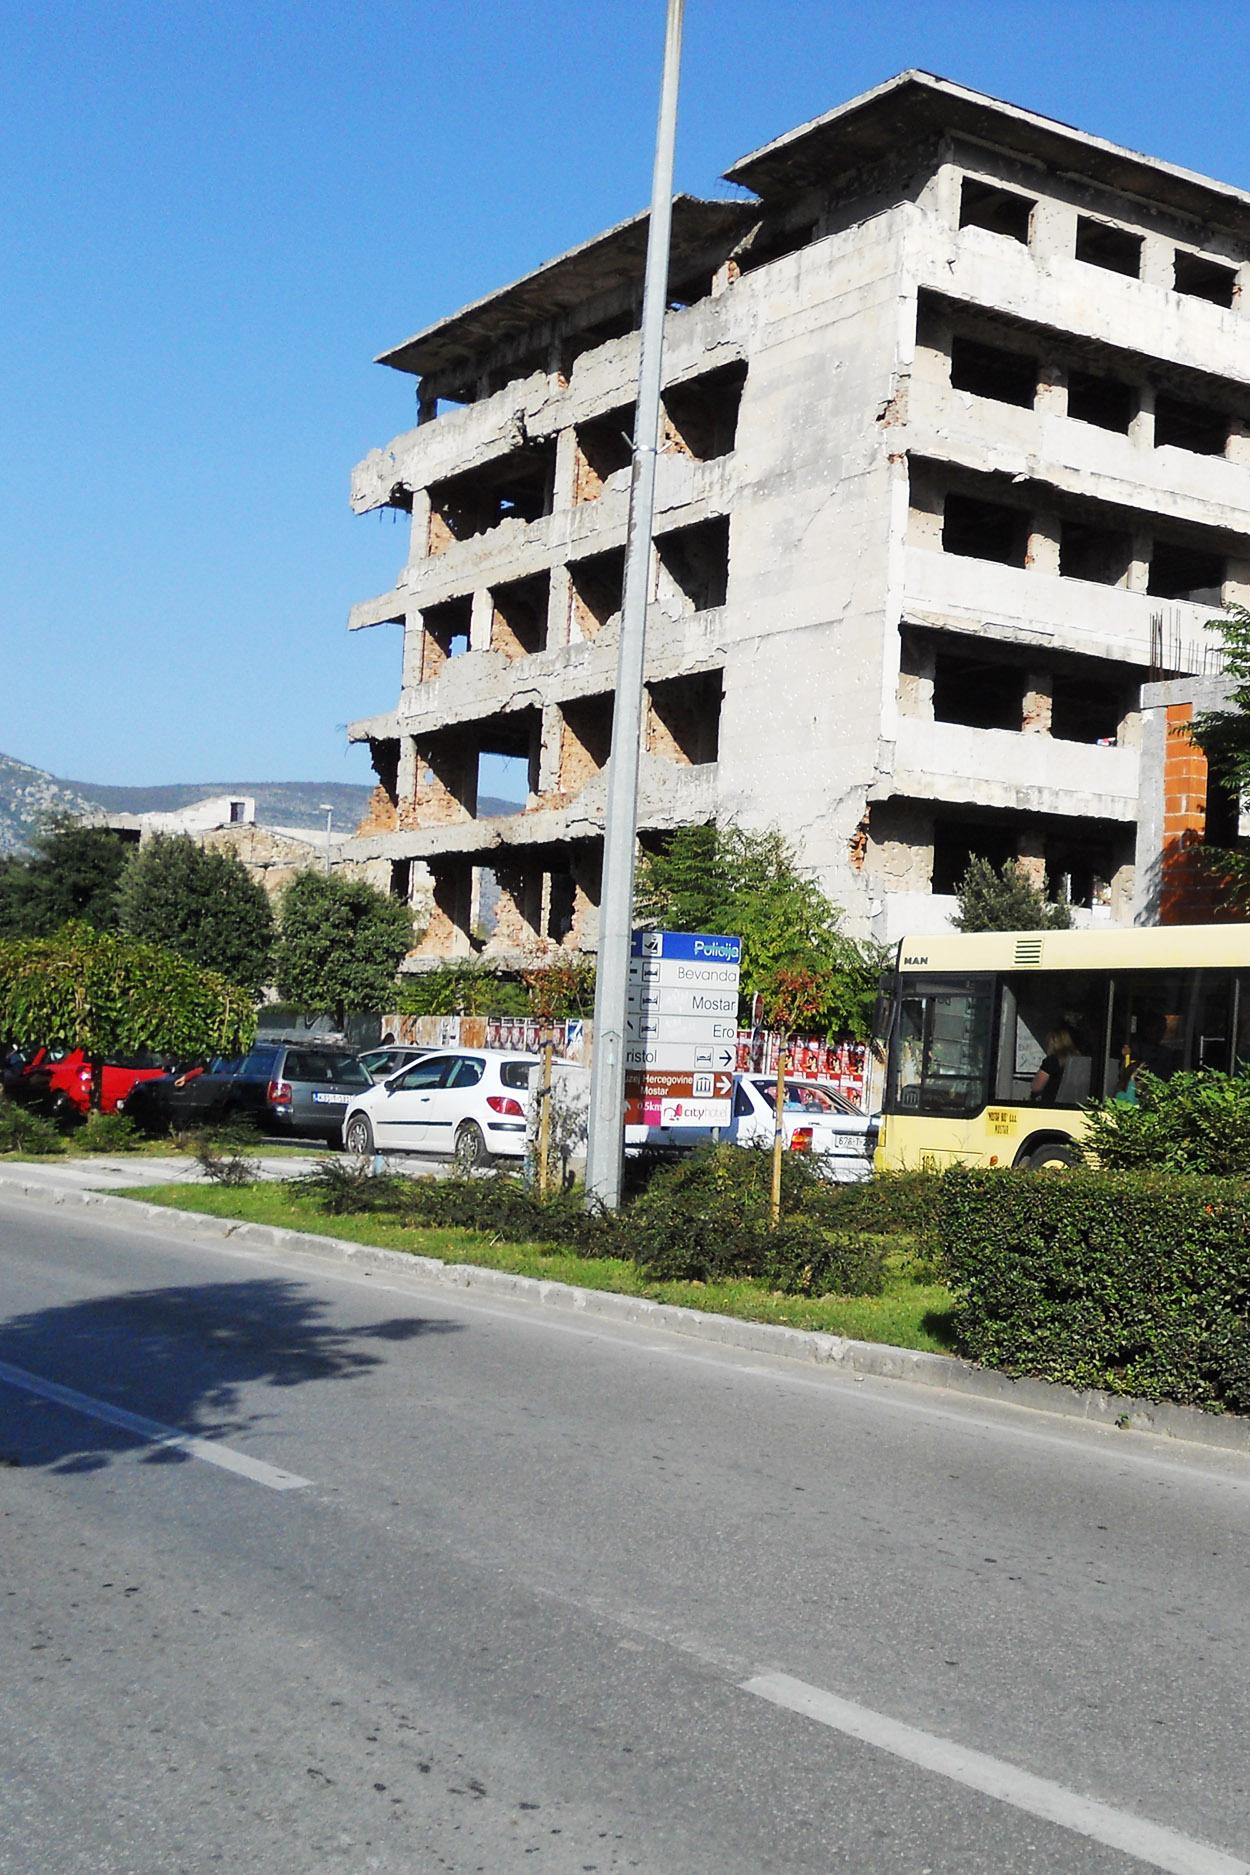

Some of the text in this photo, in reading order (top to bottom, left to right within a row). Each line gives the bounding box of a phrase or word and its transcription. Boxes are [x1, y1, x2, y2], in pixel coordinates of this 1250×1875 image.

[694, 940, 740, 961] Policija
[904, 956, 929, 965] MAN
[677, 966, 737, 983] Bevanda
[692, 996, 736, 1011] Mostar
[713, 1024, 735, 1039] Ero
[626, 1049, 658, 1064] ristol
[643, 1073, 693, 1086] Hercegovine
[641, 1086, 669, 1096] Mostar
